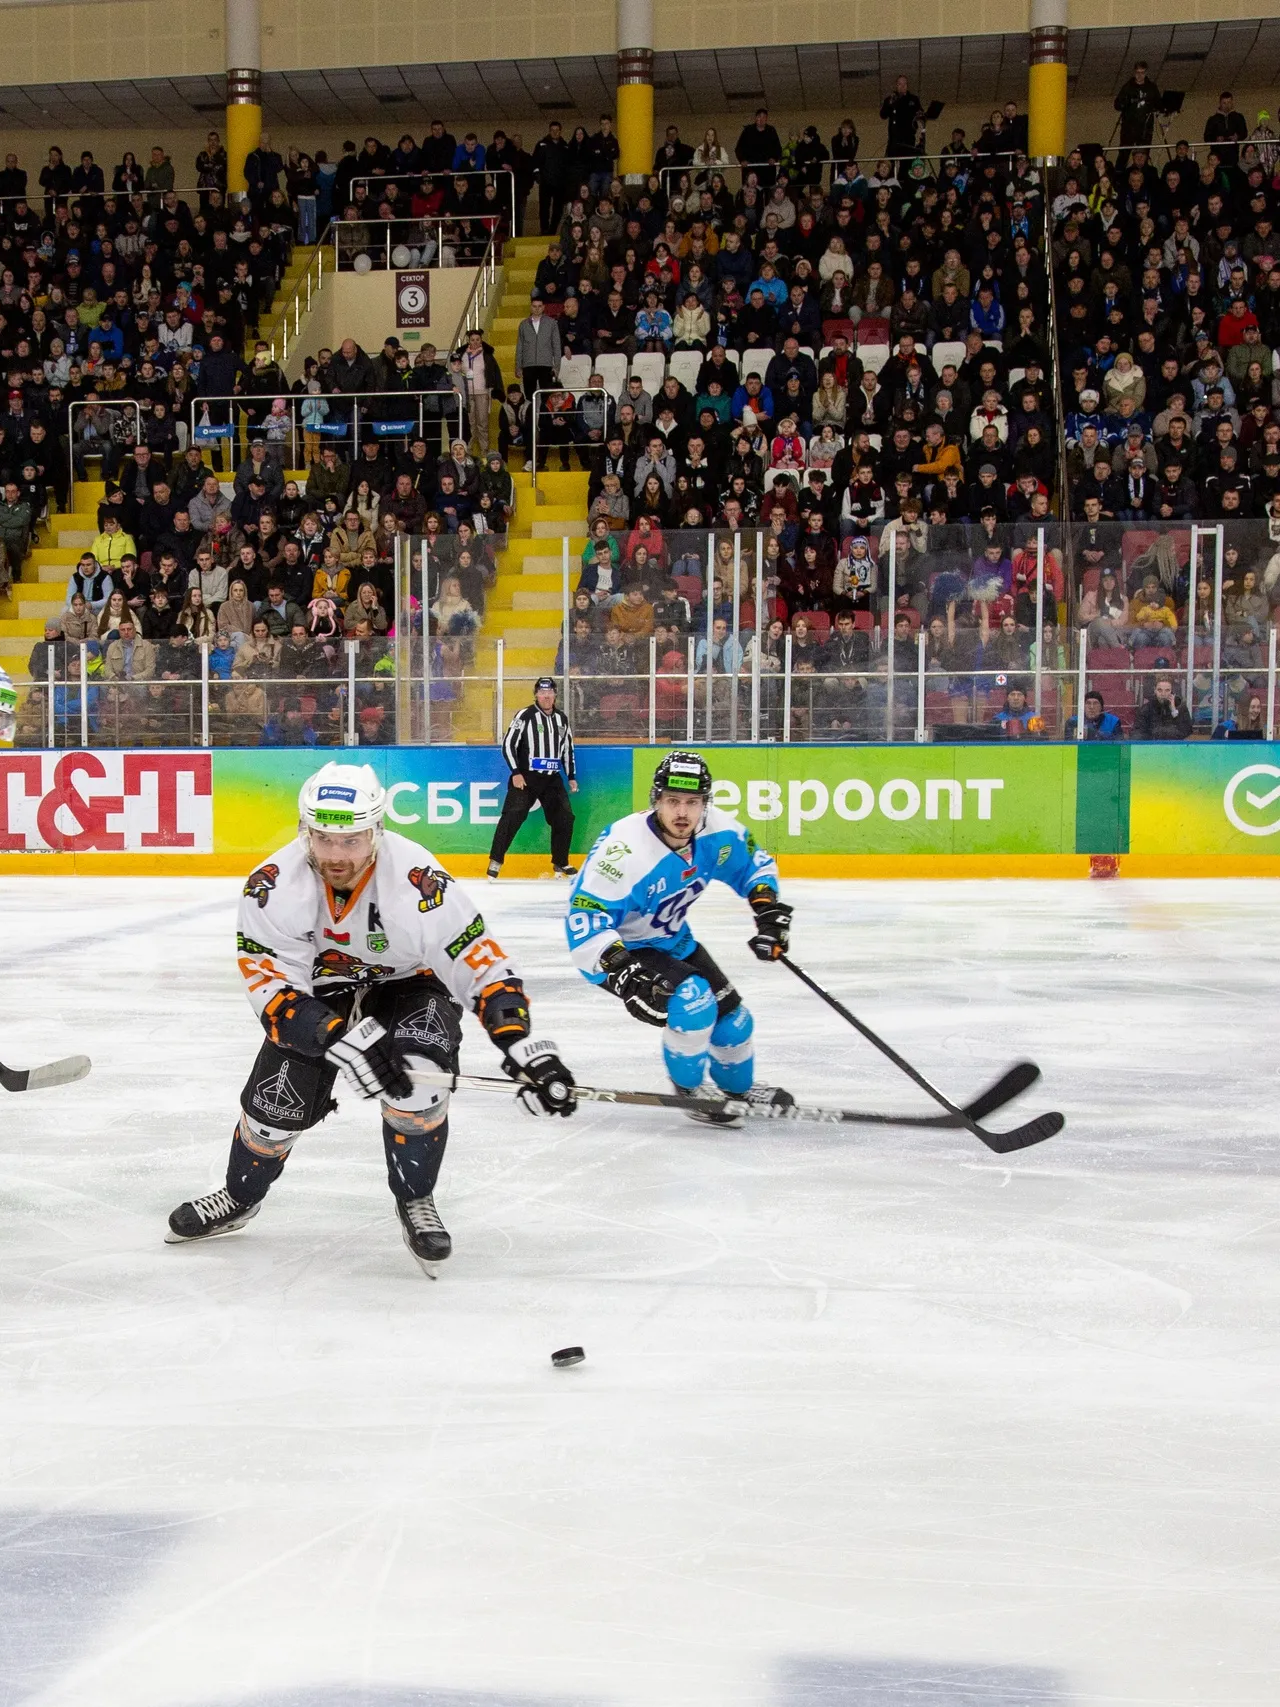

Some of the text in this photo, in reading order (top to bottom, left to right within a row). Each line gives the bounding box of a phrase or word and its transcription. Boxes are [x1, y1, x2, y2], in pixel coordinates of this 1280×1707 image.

[408, 291, 418, 307] 3
[385, 781, 542, 825] СБЕ
[316, 812, 352, 821] BETERA
[252, 1096, 304, 1120] BELARUSKALI
